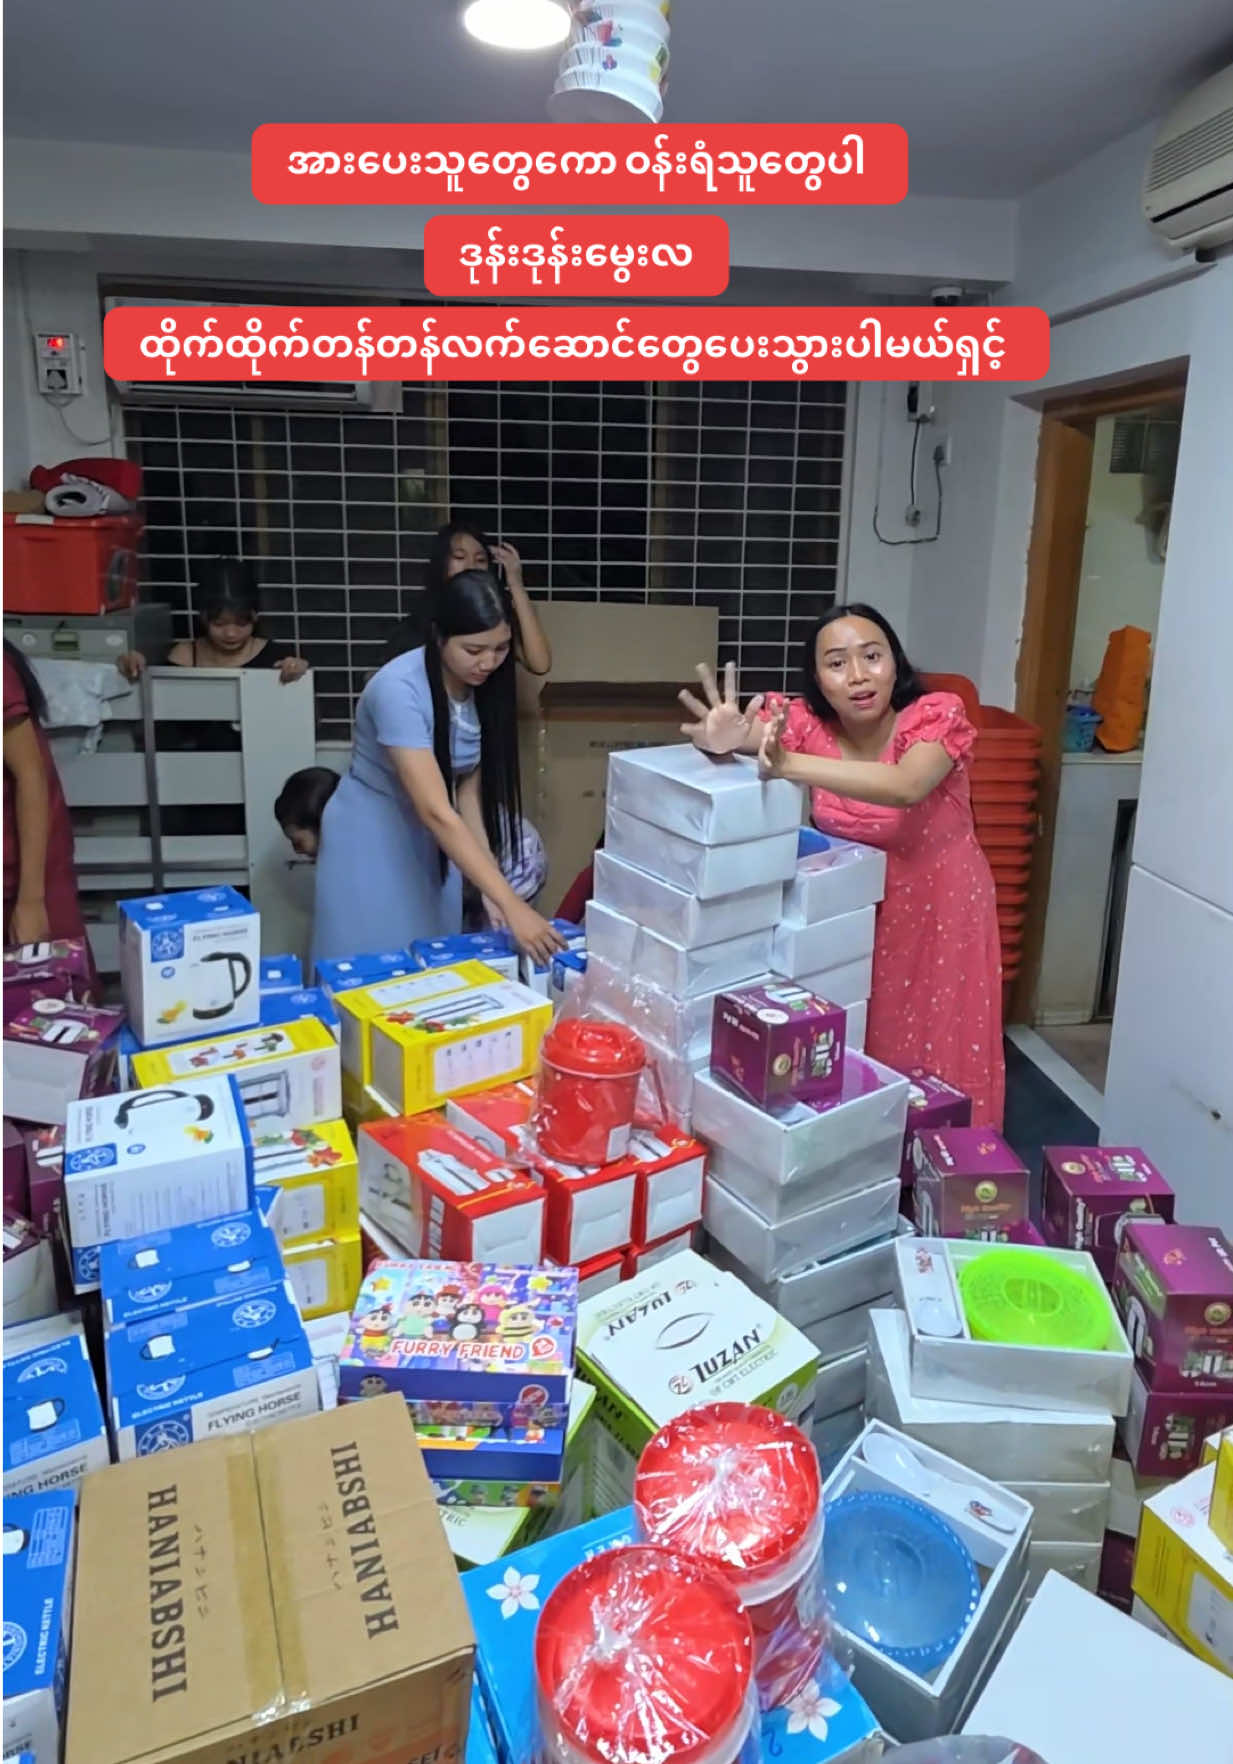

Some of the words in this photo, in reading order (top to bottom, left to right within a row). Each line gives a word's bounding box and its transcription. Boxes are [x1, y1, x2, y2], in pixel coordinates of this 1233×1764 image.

[391, 1339, 456, 1356] FURRY
[458, 1342, 525, 1360] FRIEND
[207, 1406, 257, 1432] FLYING
[258, 1391, 302, 1414] HORSE
[37, 1462, 88, 1490] HORSE
[330, 1440, 400, 1639] HANIABSHI
[146, 1484, 188, 1703] HANIABSHI
